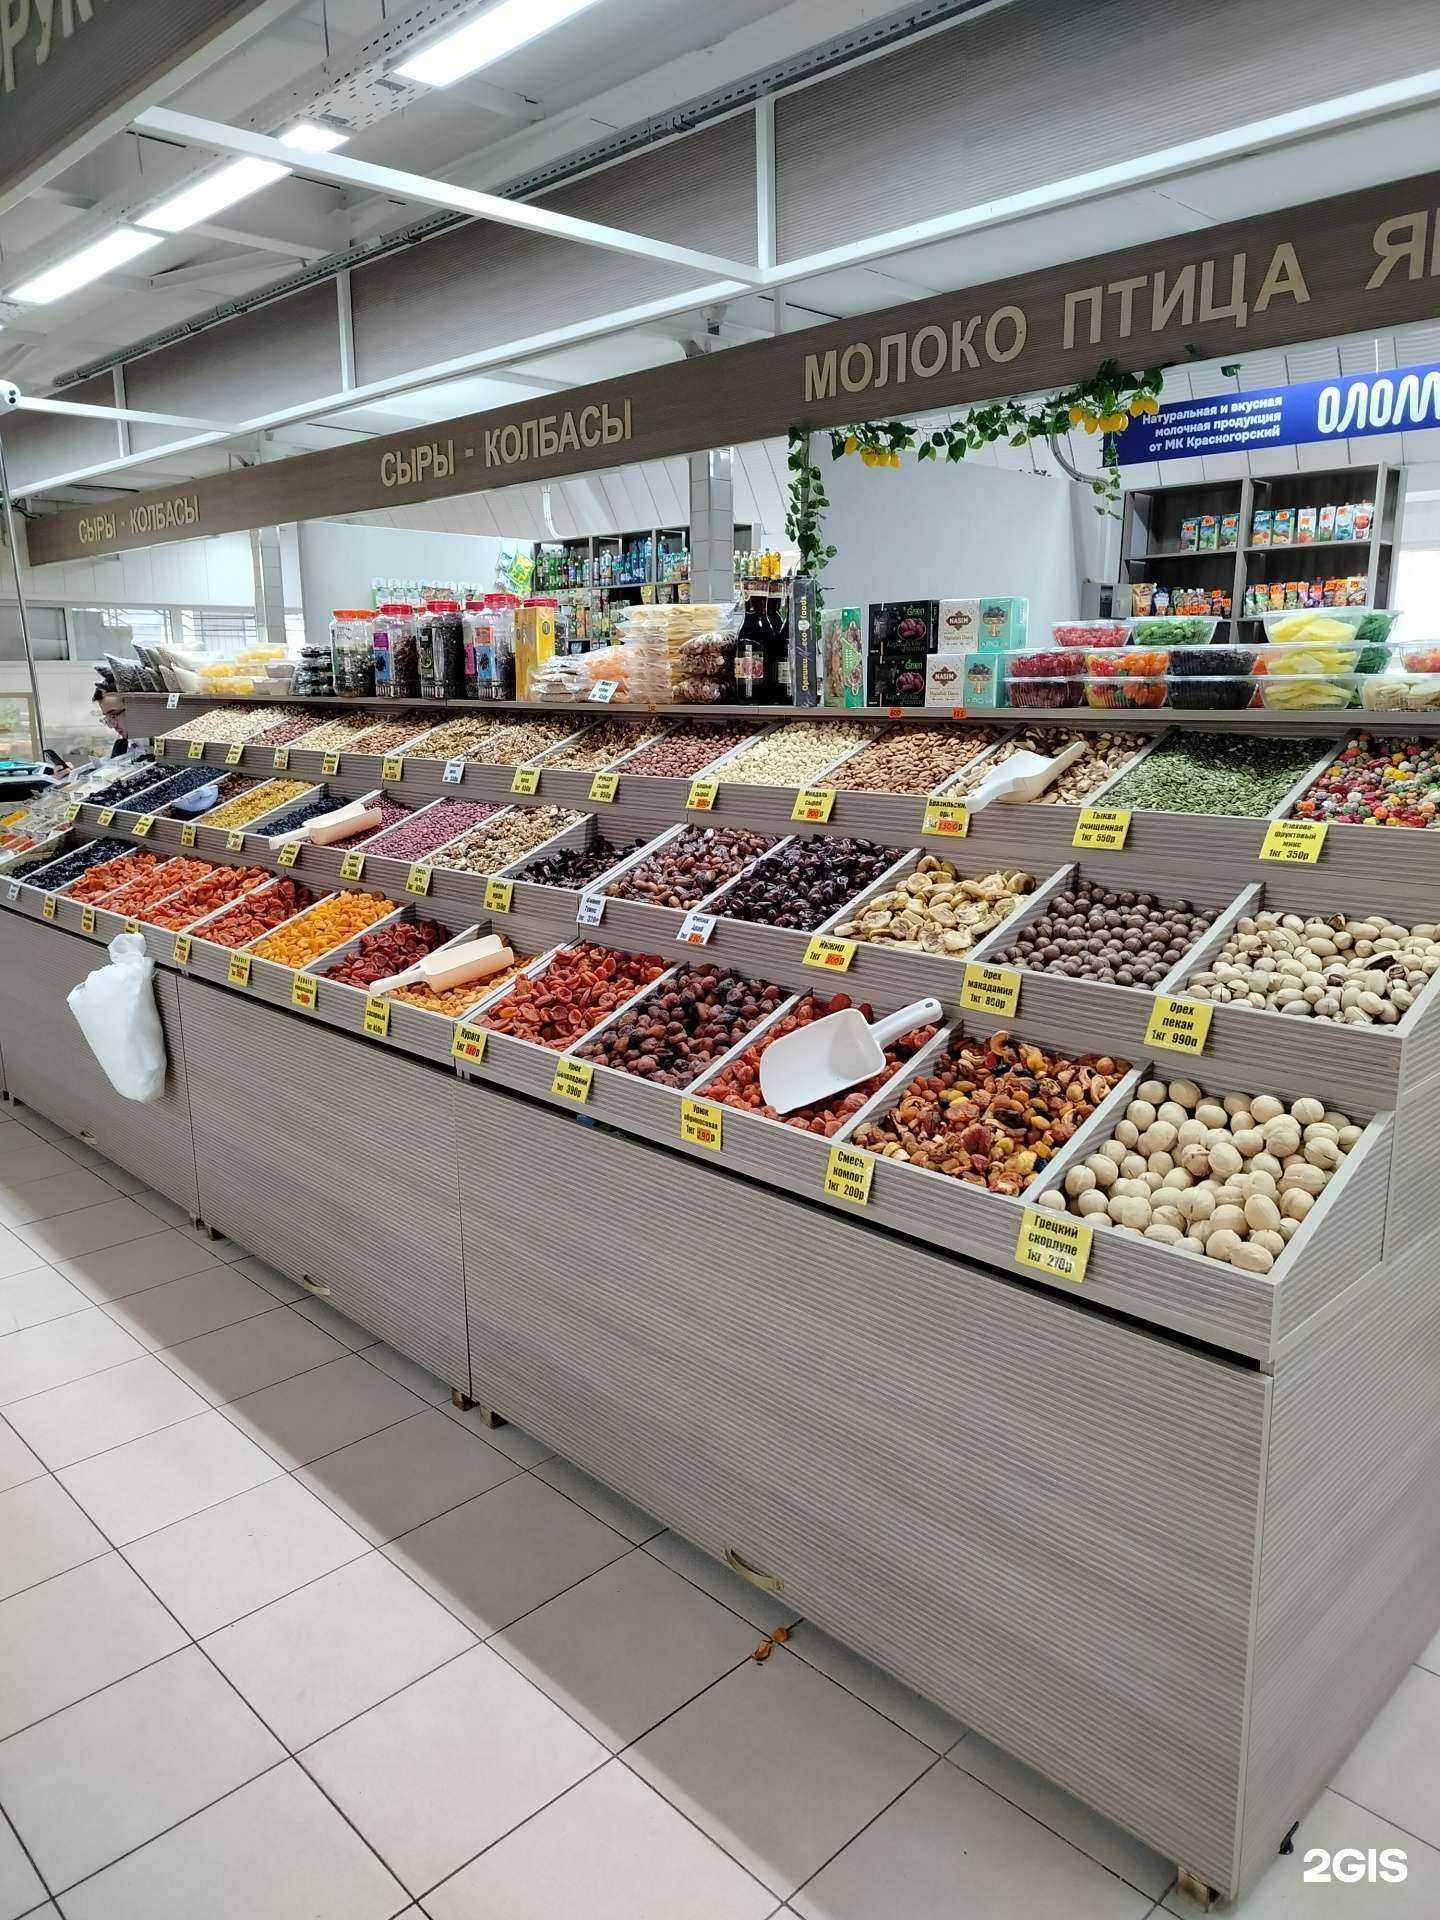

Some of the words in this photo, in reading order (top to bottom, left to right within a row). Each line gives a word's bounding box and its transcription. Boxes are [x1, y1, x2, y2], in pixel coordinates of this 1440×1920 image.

[804, 305, 1028, 402] МОЛОКО
[1062, 240, 1311, 350] ПТИЦА
[1142, 404, 1217, 425] Натуральная
[1221, 403, 1229, 412] и
[1231, 396, 1283, 412] вкусная
[1155, 421, 1211, 438] молочная
[1213, 411, 1281, 430] продукция
[380, 439, 455, 487] СЫРЫ
[485, 399, 633, 468] КОЛБАСЫ
[1149, 443, 1164, 453] от
[1165, 438, 1184, 451] МК
[1186, 426, 1281, 449] Красногорский
[79, 513, 117, 544] СЫРЫ
[129, 495, 200, 534] КОЛБАСЫ
[934, 672, 954, 680] NASIM
[804, 790, 828, 799] Миндаль
[804, 799, 822, 807] сырой
[1093, 811, 1117, 820] Тыква
[1080, 823, 1123, 832] очищенная
[1096, 834, 1116, 843] 550р
[1274, 831, 1317, 840] фруктовый
[1268, 849, 1282, 857] 1кг
[1286, 850, 1309, 860] 350р
[819, 939, 846, 952] Инжир
[810, 951, 822, 960] 1кг
[983, 969, 1002, 981] Орех
[968, 980, 1013, 996] макадамия
[970, 994, 981, 1003] 1кг
[985, 996, 1006, 1009] 850р
[1169, 1002, 1195, 1015] Орех
[1162, 1017, 1194, 1030] пекан
[461, 1028, 480, 1042] Курага
[1152, 1029, 1166, 1041] 1кг
[1171, 1033, 1198, 1047] 990р
[456, 1041, 465, 1052] 1кг
[692, 1104, 709, 1116] Урюк
[686, 1125, 696, 1135] 1кг
[838, 1150, 864, 1168] Смесь
[833, 1167, 864, 1184] компот
[828, 1179, 839, 1192] 1кг
[844, 1184, 865, 1200] 200р
[1034, 1215, 1078, 1239] Грецкий
[1028, 1232, 1077, 1256] скорлупе
[1027, 1248, 1041, 1262] 1кг
[1047, 1255, 1073, 1273] 270р
